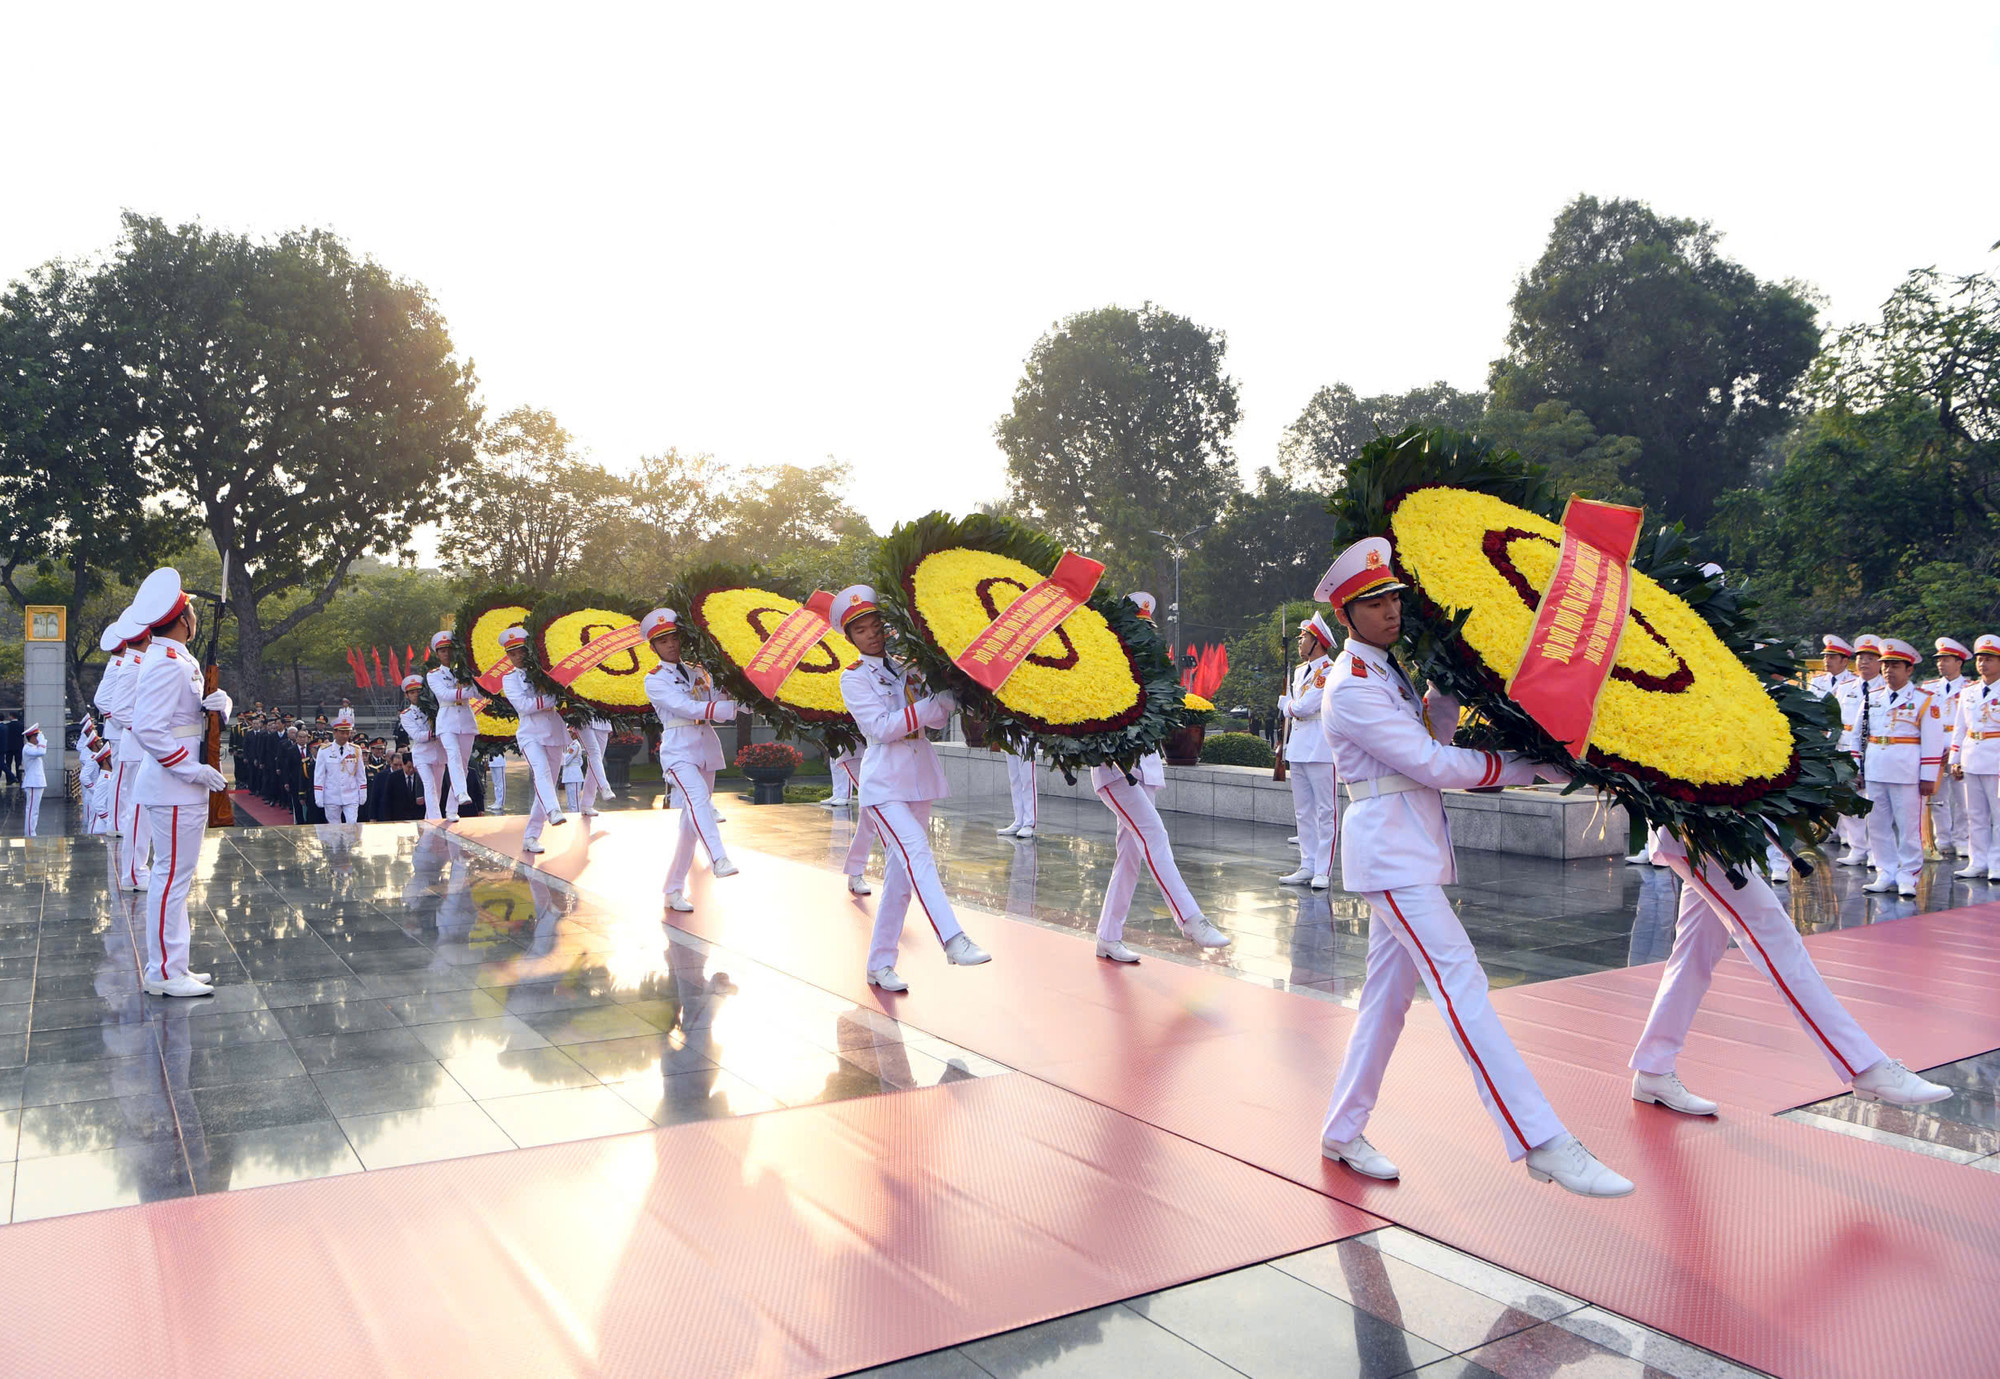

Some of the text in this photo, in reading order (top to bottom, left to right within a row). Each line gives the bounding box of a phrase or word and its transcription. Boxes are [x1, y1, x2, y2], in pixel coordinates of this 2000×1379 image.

[1563, 579, 1594, 602] CÁC
[1550, 605, 1583, 633] NHỚ
[1543, 625, 1578, 648] ĐỜI
[1536, 642, 1573, 664] ĐỜI
